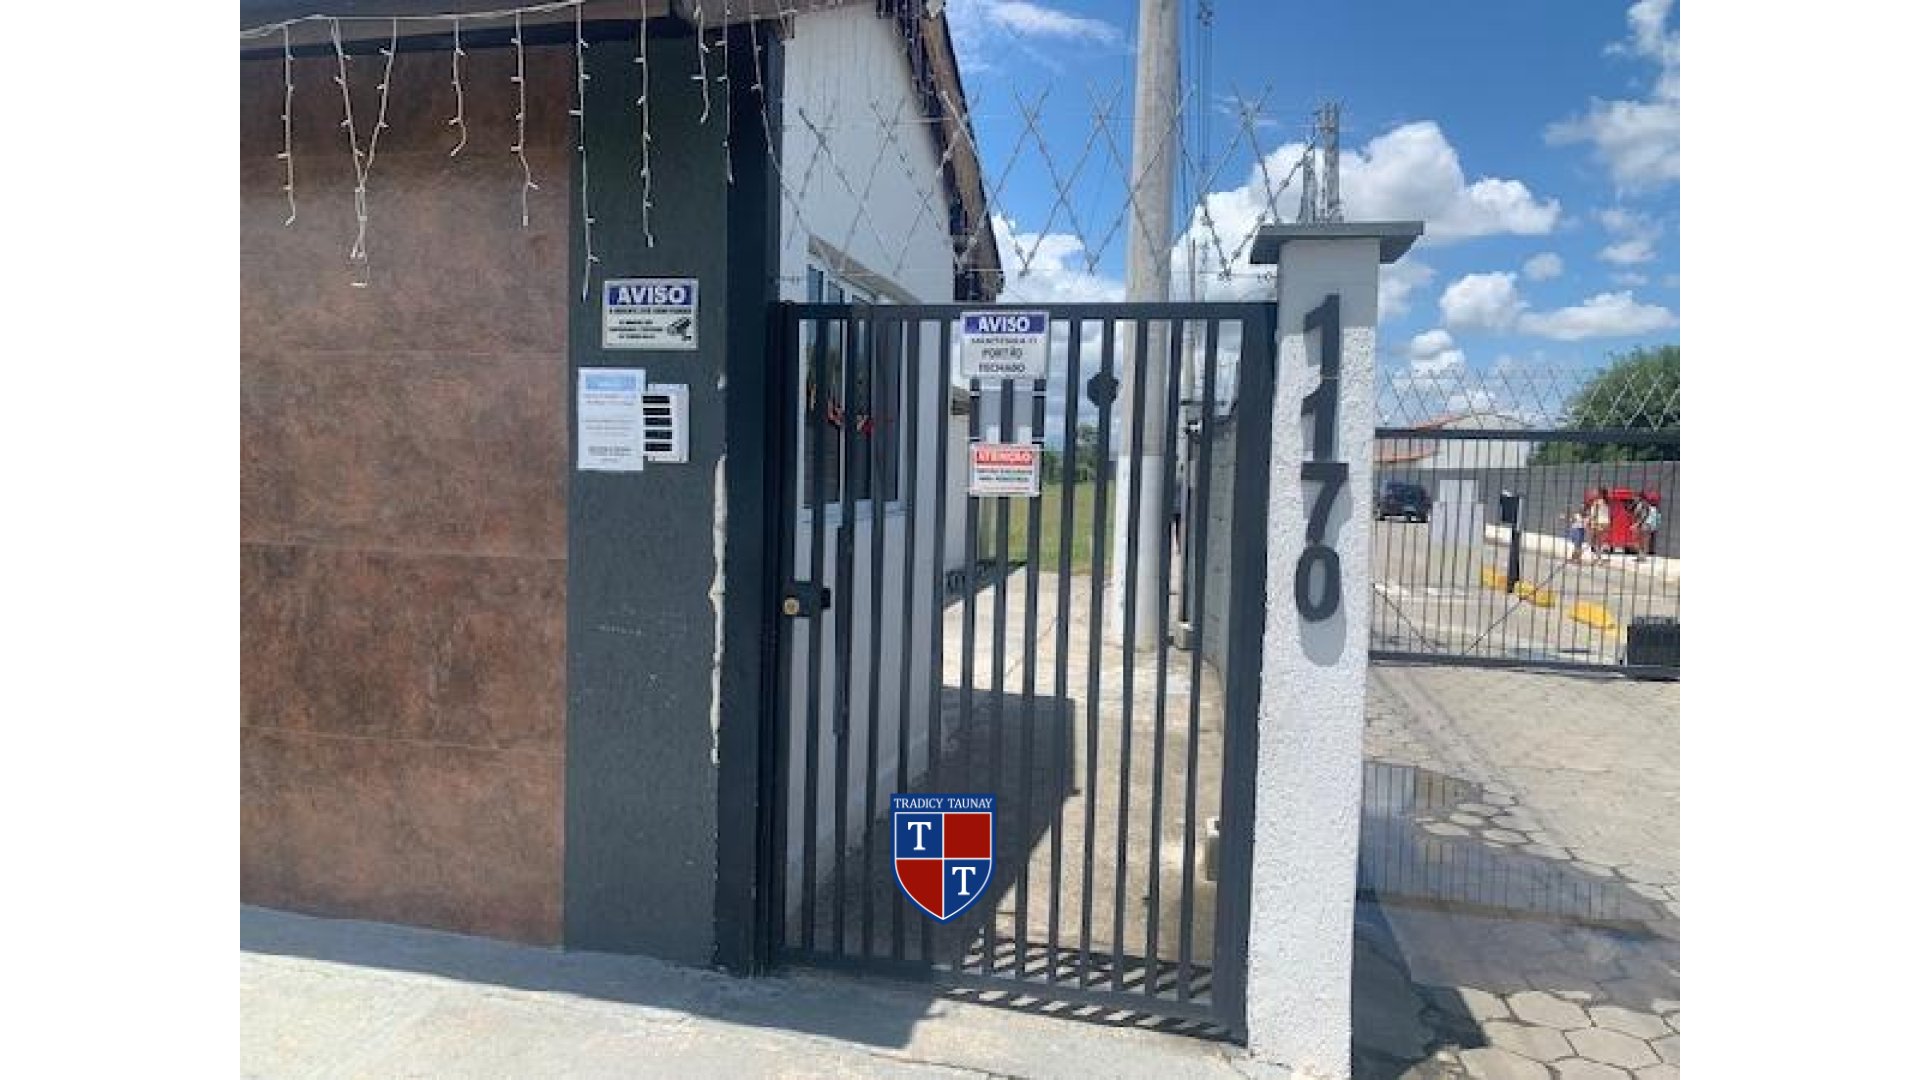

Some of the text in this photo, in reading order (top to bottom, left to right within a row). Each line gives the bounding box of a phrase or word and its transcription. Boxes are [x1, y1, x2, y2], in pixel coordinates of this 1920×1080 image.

[617, 286, 686, 304] AVISO
[978, 315, 1031, 332] AVISO
[1295, 294, 1349, 622] 1170
